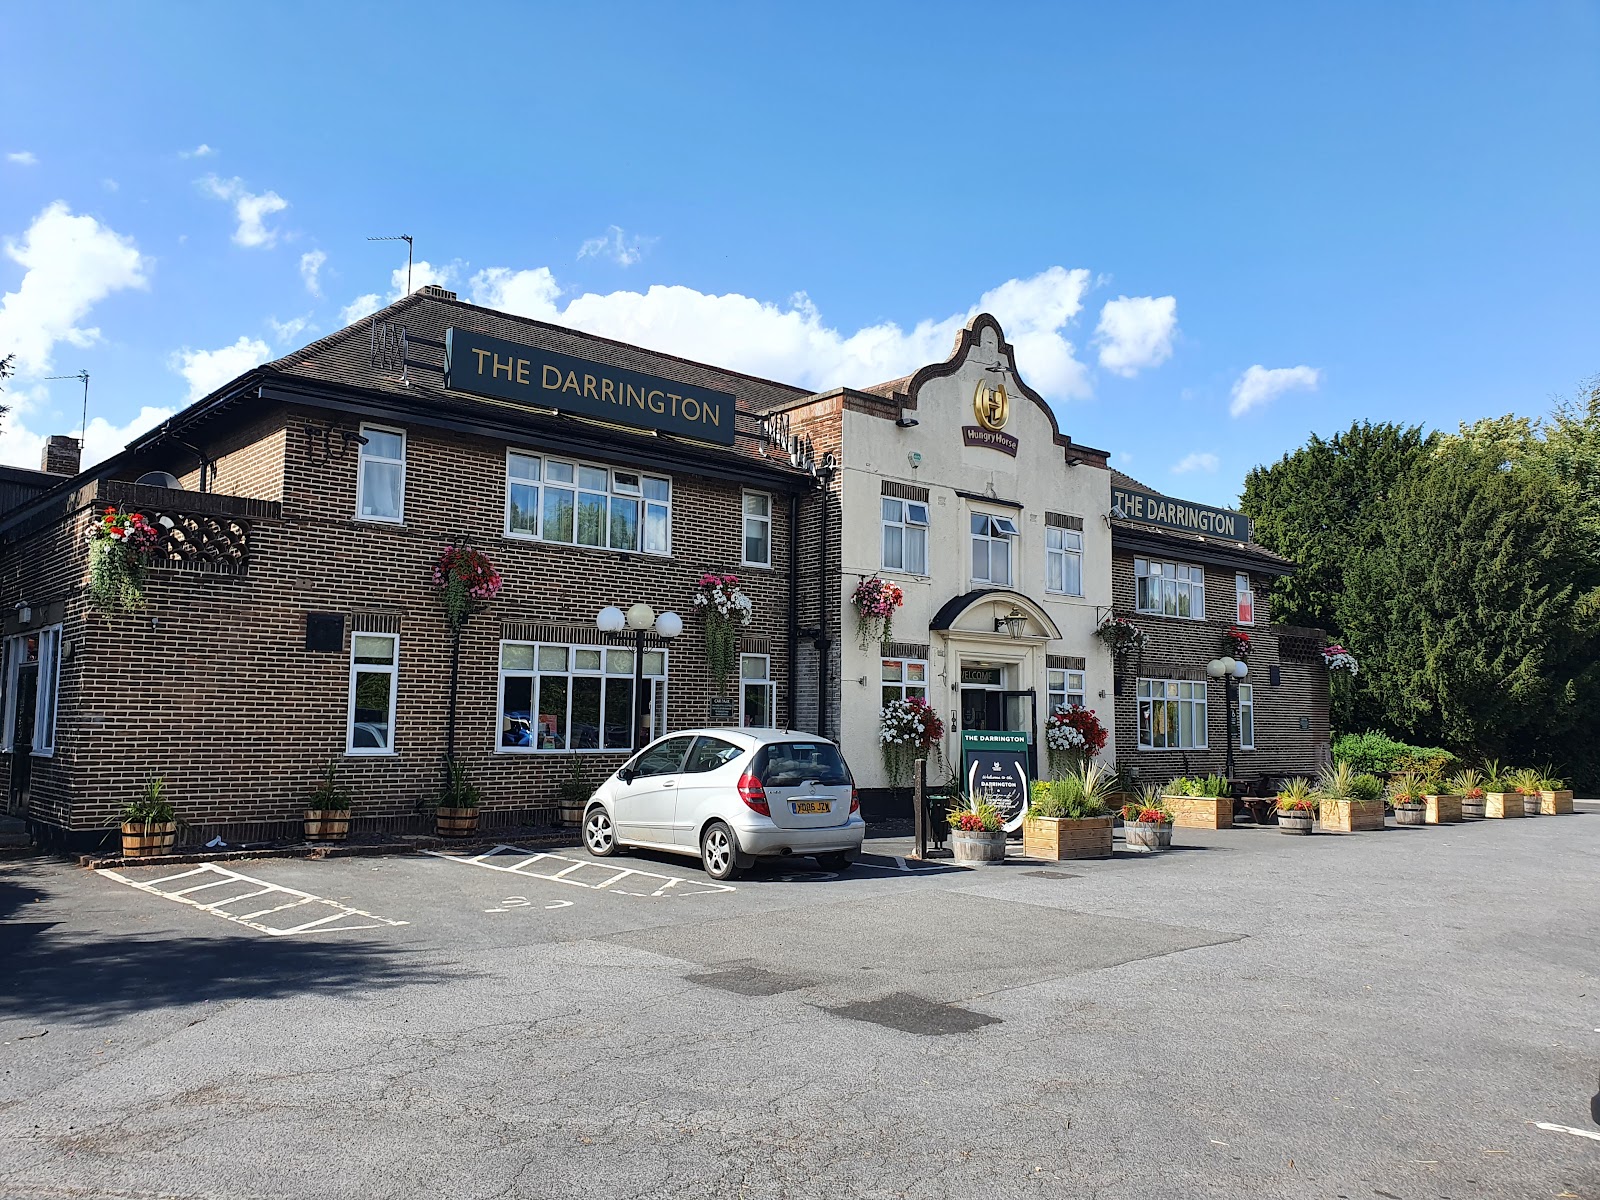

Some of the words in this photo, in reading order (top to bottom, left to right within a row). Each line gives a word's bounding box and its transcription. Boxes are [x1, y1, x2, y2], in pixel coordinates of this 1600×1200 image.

[471, 348, 531, 386] THE
[542, 364, 721, 427] DARRINGTON
[1114, 491, 1143, 518] THE
[1147, 498, 1235, 536] DARRINGTON
[980, 735, 1025, 743] DARRINGTON
